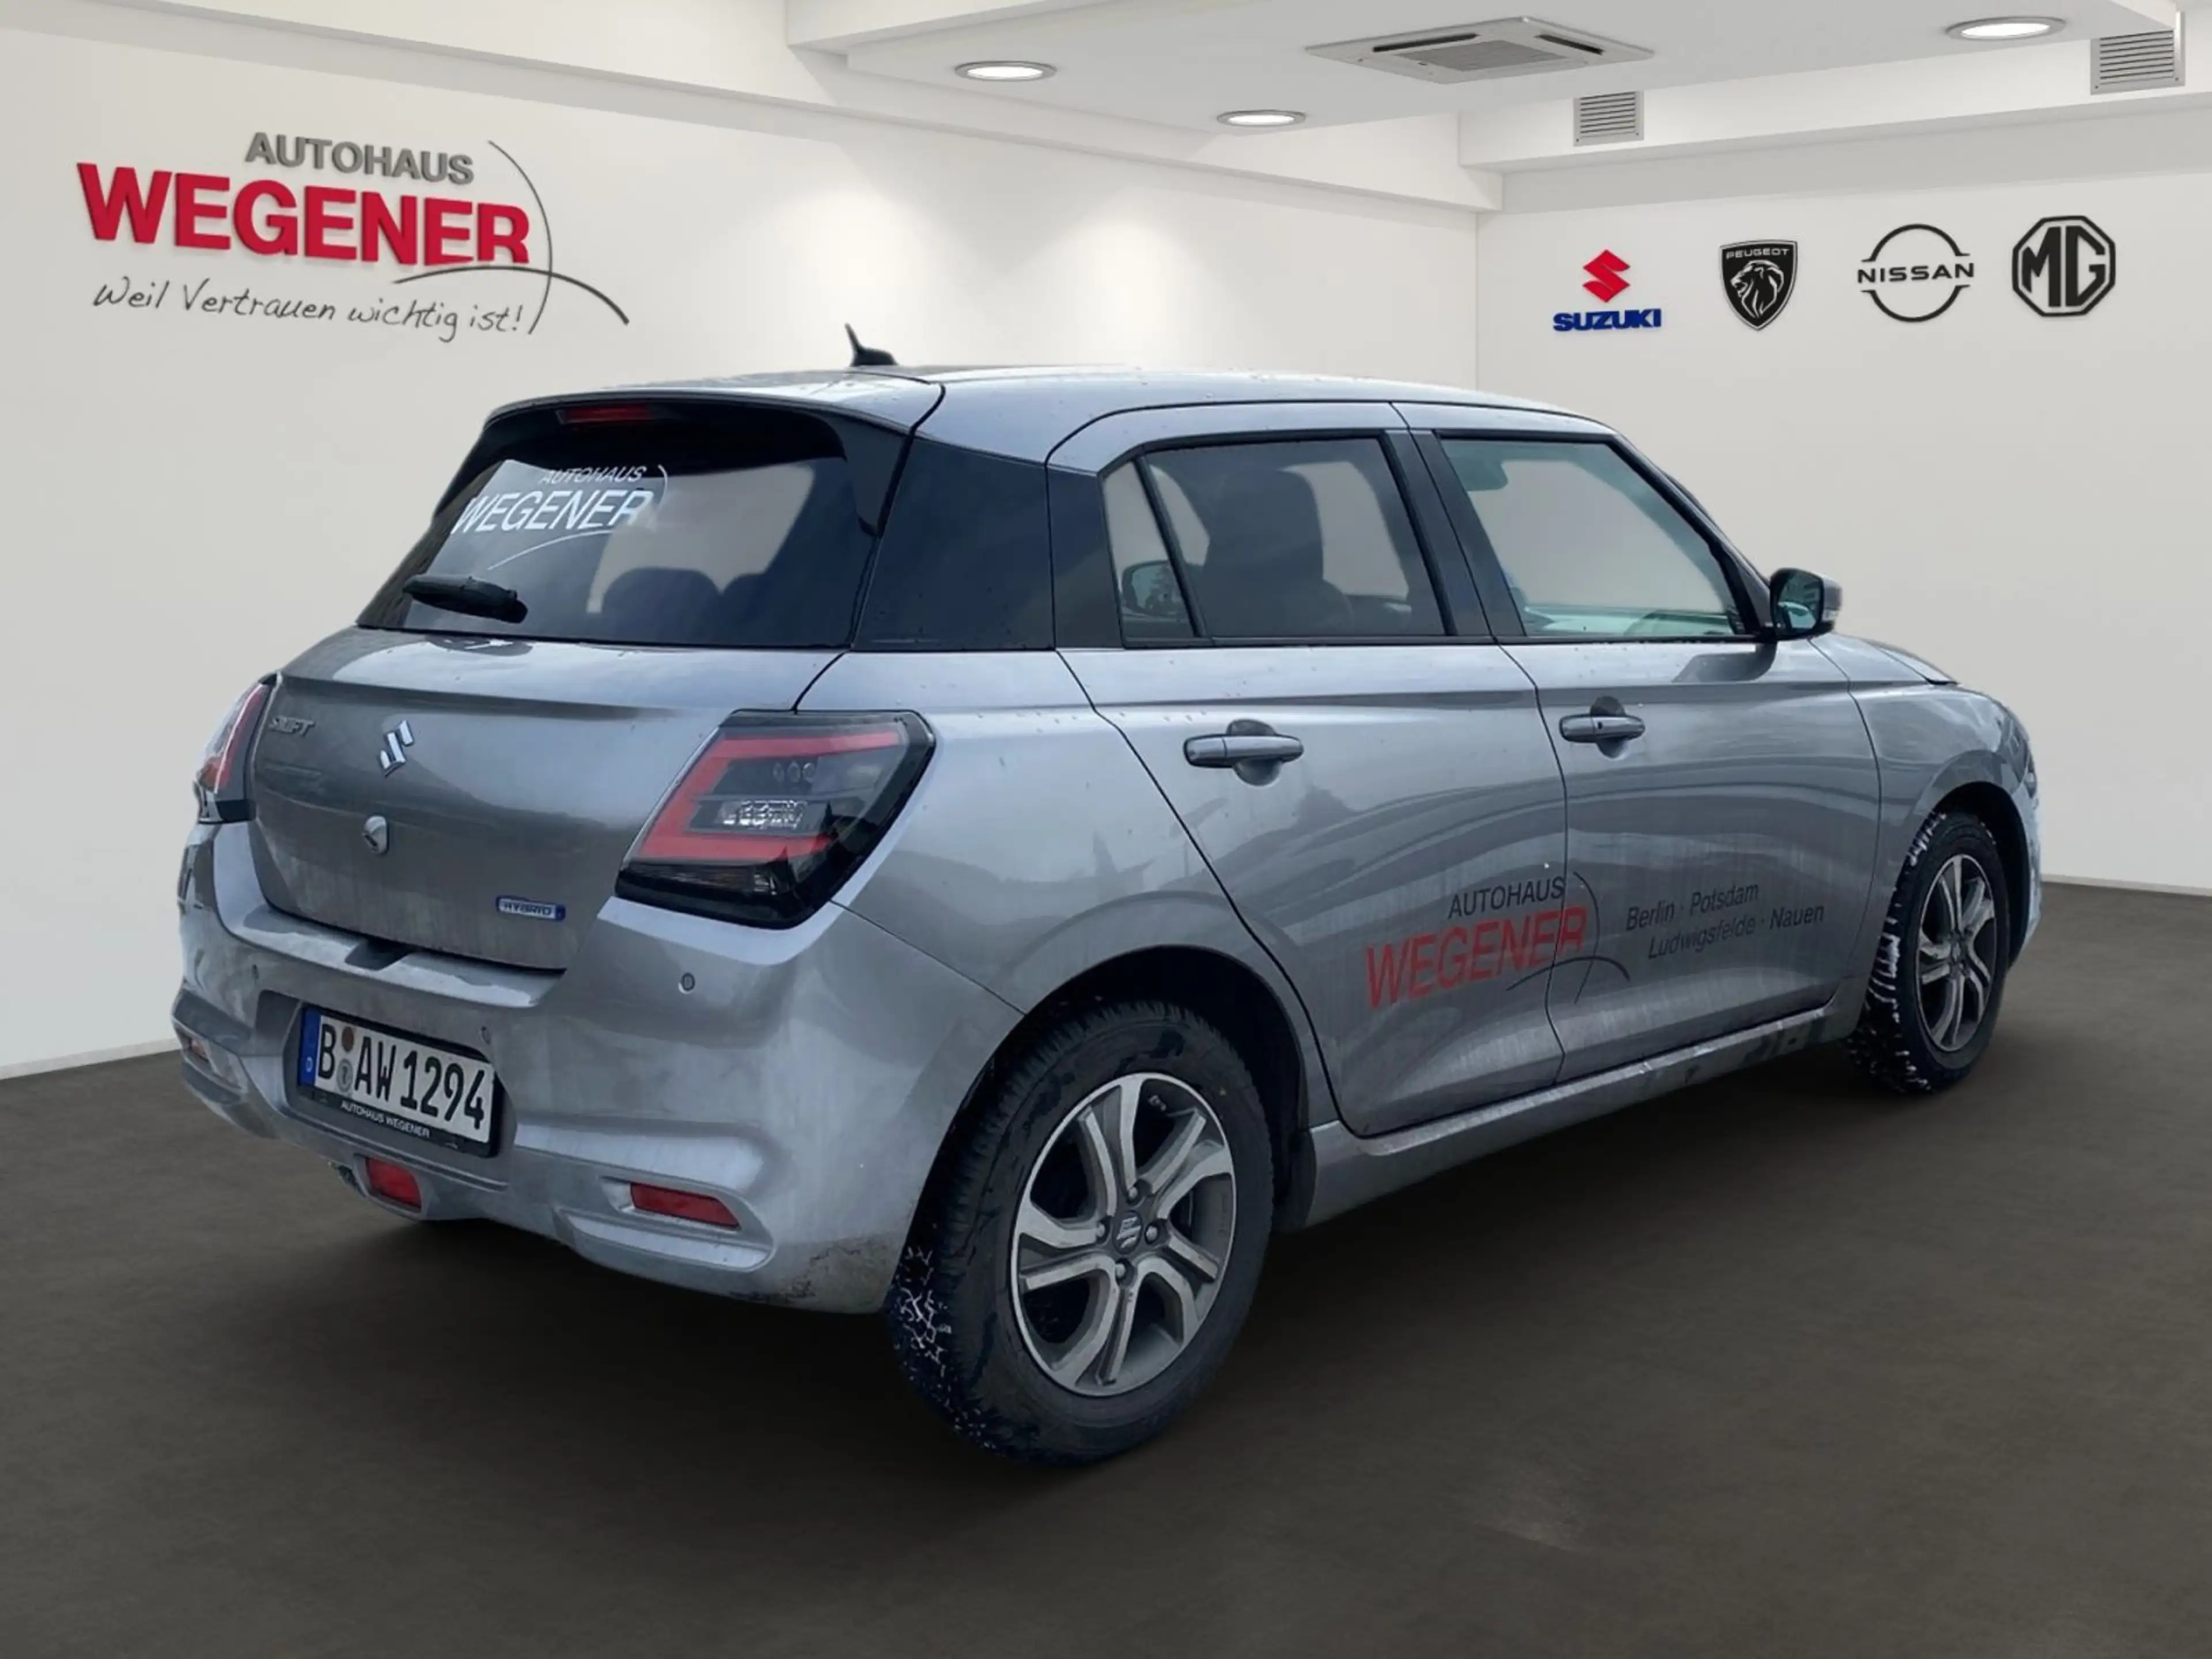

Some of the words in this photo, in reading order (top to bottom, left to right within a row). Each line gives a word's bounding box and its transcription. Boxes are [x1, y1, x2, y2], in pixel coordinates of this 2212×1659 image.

[245, 132, 474, 185] AUTOHAUS
[76, 162, 531, 267] WEGENER
[1726, 248, 1790, 259] PEUGEOT
[1857, 262, 1974, 285] NISSAN
[2022, 225, 2107, 308] MG
[93, 276, 169, 309] Weil
[183, 276, 336, 323] Vertrauen
[346, 298, 459, 342] wichtig
[468, 304, 524, 332] ist!
[1552, 308, 1662, 332] SUZUKI
[538, 465, 647, 485] AUTOHAUS
[450, 490, 654, 535] WEGENER
[1449, 876, 1565, 918] AUTOHAUS
[1626, 897, 1675, 931] Berlin
[1690, 882, 1759, 914] Potsdam
[1366, 906, 1588, 1007] WEGENER
[1649, 916, 1756, 959] Ludwigsfelde
[1770, 905, 1824, 929] Nauen
[318, 1023, 336, 1080] B
[354, 1036, 396, 1101] AW
[400, 1050, 485, 1130] 1294
[340, 1100, 385, 1124] AUTOHAUS
[385, 1116, 430, 1139] WEGENER
